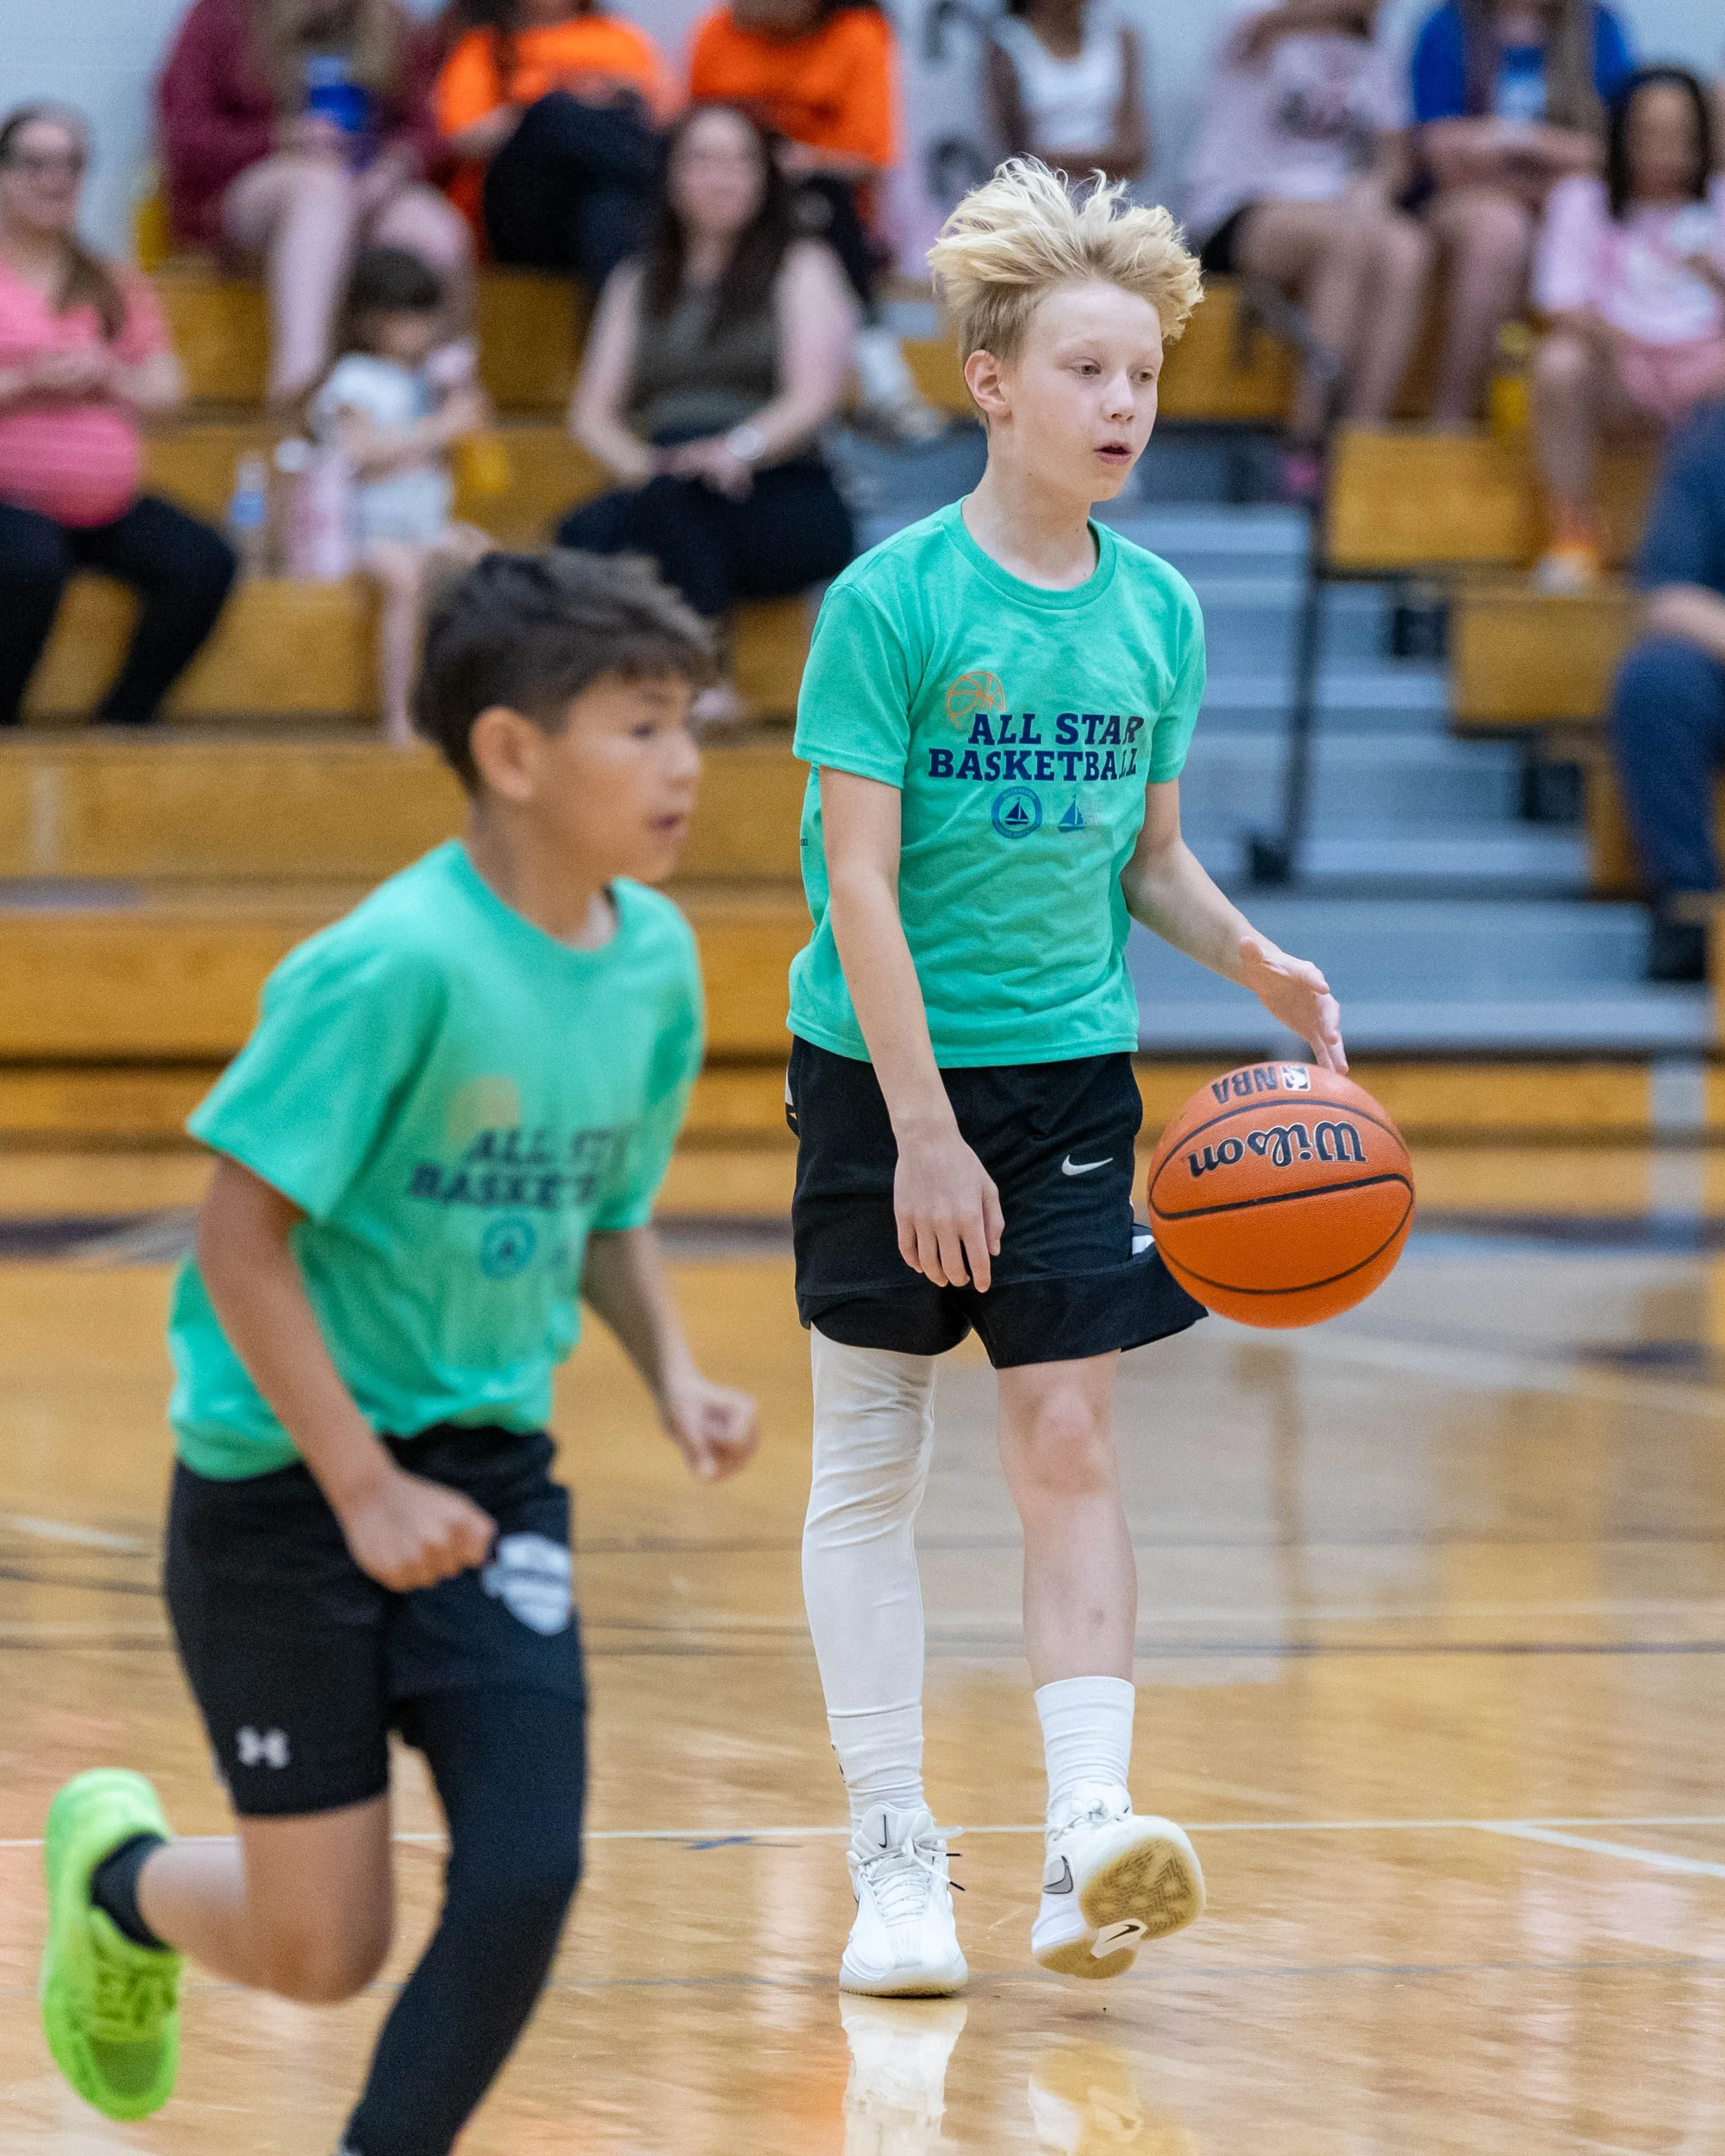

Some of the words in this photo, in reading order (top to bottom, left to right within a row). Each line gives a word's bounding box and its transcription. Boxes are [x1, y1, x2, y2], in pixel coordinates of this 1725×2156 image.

[969, 713, 1041, 745] ALL
[1056, 713, 1144, 746] STAR
[929, 749, 1138, 781] BASKETBALL
[1212, 1067, 1277, 1104] NBA
[1187, 1121, 1367, 1177] Wilson
